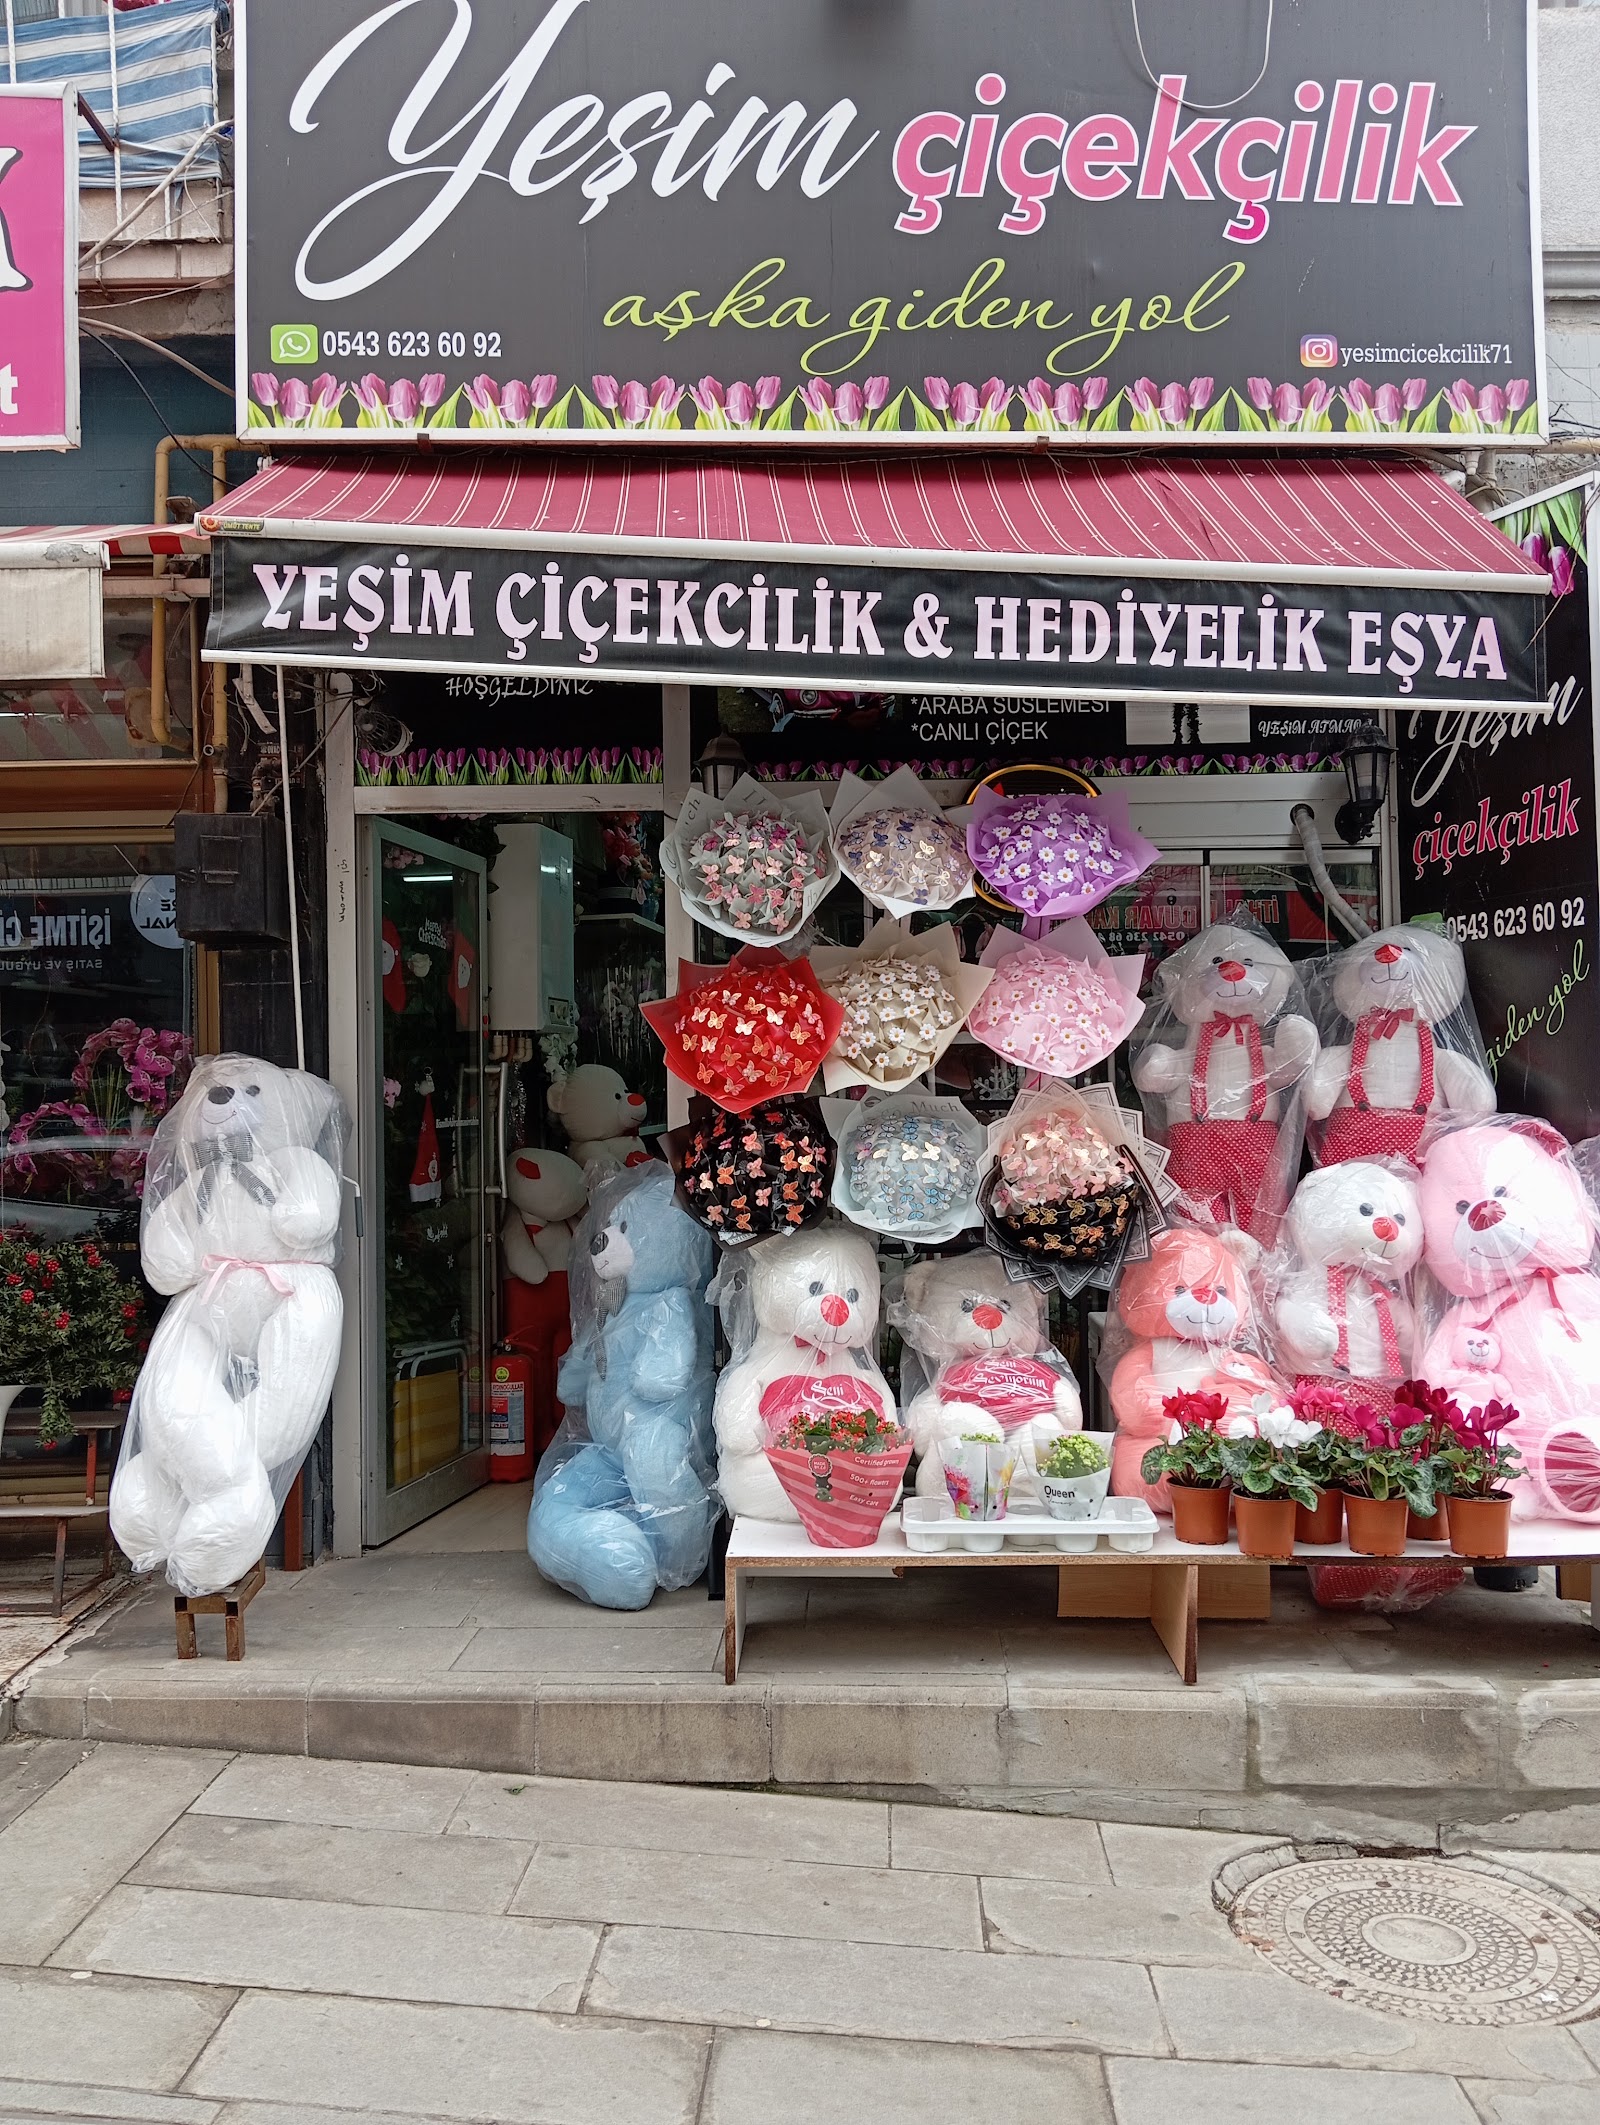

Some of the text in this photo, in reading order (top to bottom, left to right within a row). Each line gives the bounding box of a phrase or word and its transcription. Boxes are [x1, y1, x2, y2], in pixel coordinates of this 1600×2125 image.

[289, 0, 878, 300] Yeşim
[892, 73, 1478, 244] çiçekçilik
[603, 257, 1245, 376] aşka giden yol
[322, 331, 502, 358] 0543 623 60 92
[1340, 342, 1513, 367] yesimcicekcilik71
[252, 553, 1507, 694] YEŞİM ÇİÇEKCİLİK & HEDİYELİK EŞYA
[985, 718, 1049, 745] ÇİÇEK
[1411, 777, 1581, 881] çiçekçilik
[1446, 896, 1586, 943] 0543 623 60 92
[1545, 938, 1590, 1036] yol
[910, 1101, 960, 1114] Much
[854, 1456, 883, 1466] Certified
[849, 1473, 889, 1486] 500+ flowers
[1044, 1485, 1076, 1499] Queen
[849, 1494, 866, 1506] Easy
